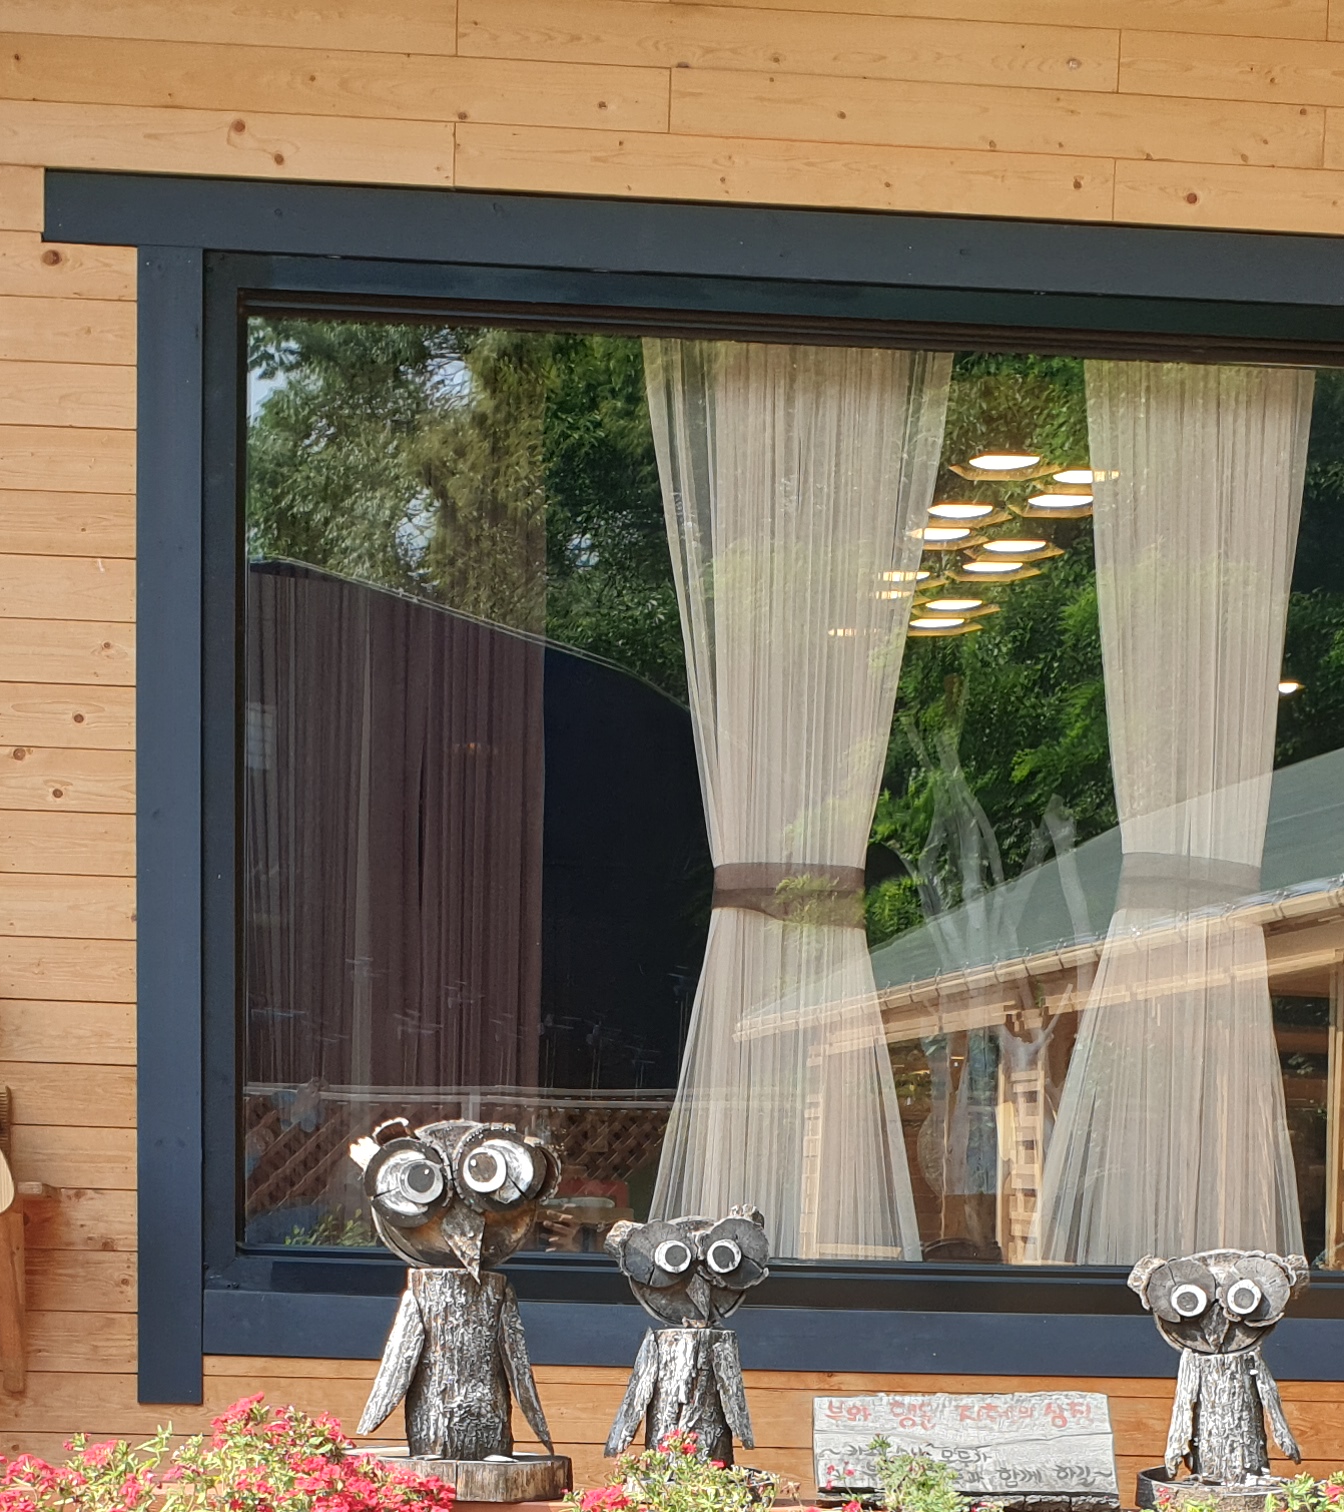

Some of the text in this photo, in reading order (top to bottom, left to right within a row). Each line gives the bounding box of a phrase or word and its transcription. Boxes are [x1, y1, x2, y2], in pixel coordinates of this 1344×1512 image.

[825, 1400, 872, 1420] 부와
[889, 1401, 936, 1431] 행운
[942, 1449, 992, 1467] 모두가
[997, 1467, 1042, 1488] 함께
